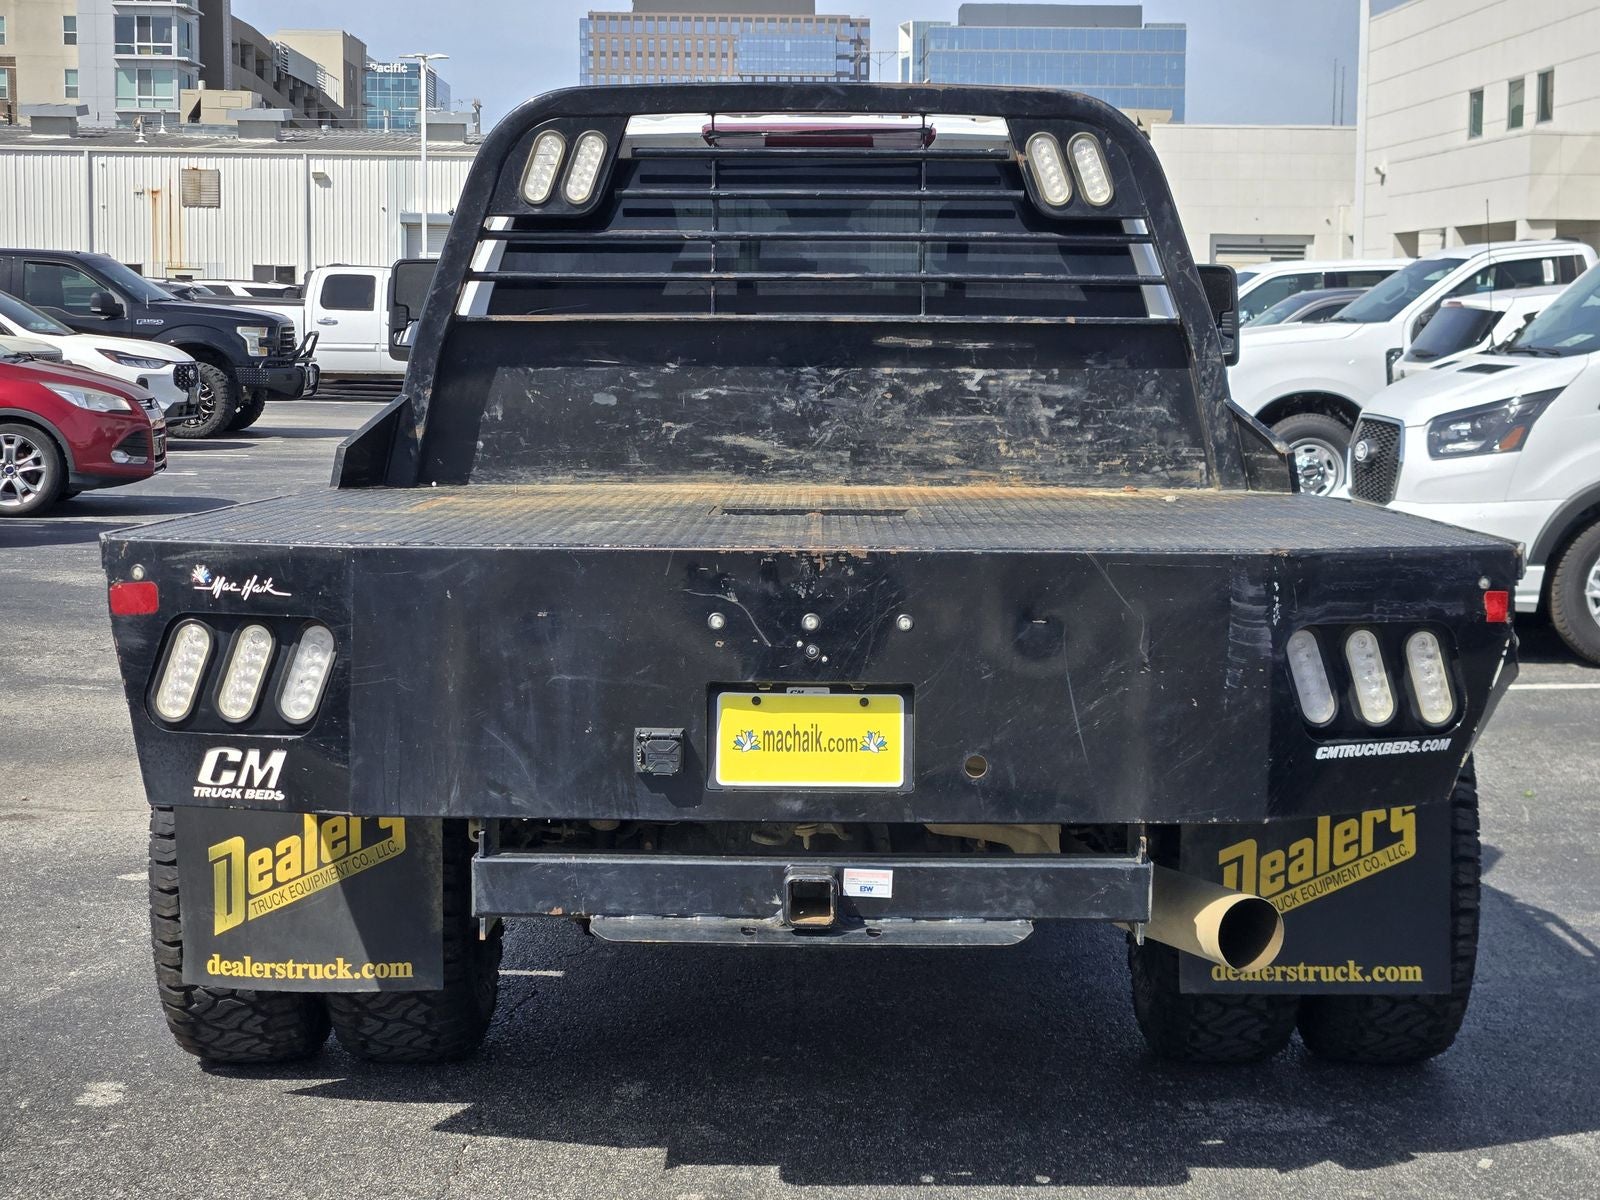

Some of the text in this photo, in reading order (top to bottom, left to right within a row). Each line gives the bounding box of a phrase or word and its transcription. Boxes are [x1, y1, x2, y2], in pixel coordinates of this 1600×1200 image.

[195, 574, 292, 600] Mac Haik
[762, 723, 858, 753] machaik.com
[1315, 738, 1451, 760] CMTRUCKBEDS.COM
[198, 746, 287, 789] CM
[193, 786, 286, 801] TRUCK BEDS
[1218, 805, 1416, 897] Dealers
[208, 814, 406, 936] Dealers
[251, 892, 288, 915] TRUCK
[288, 860, 350, 899] EQUIPMENT
[377, 839, 400, 859] LLC.
[1271, 891, 1300, 911] UCK
[1301, 863, 1361, 901] EQUIPMENT
[207, 954, 414, 980] dealerstruck.com
